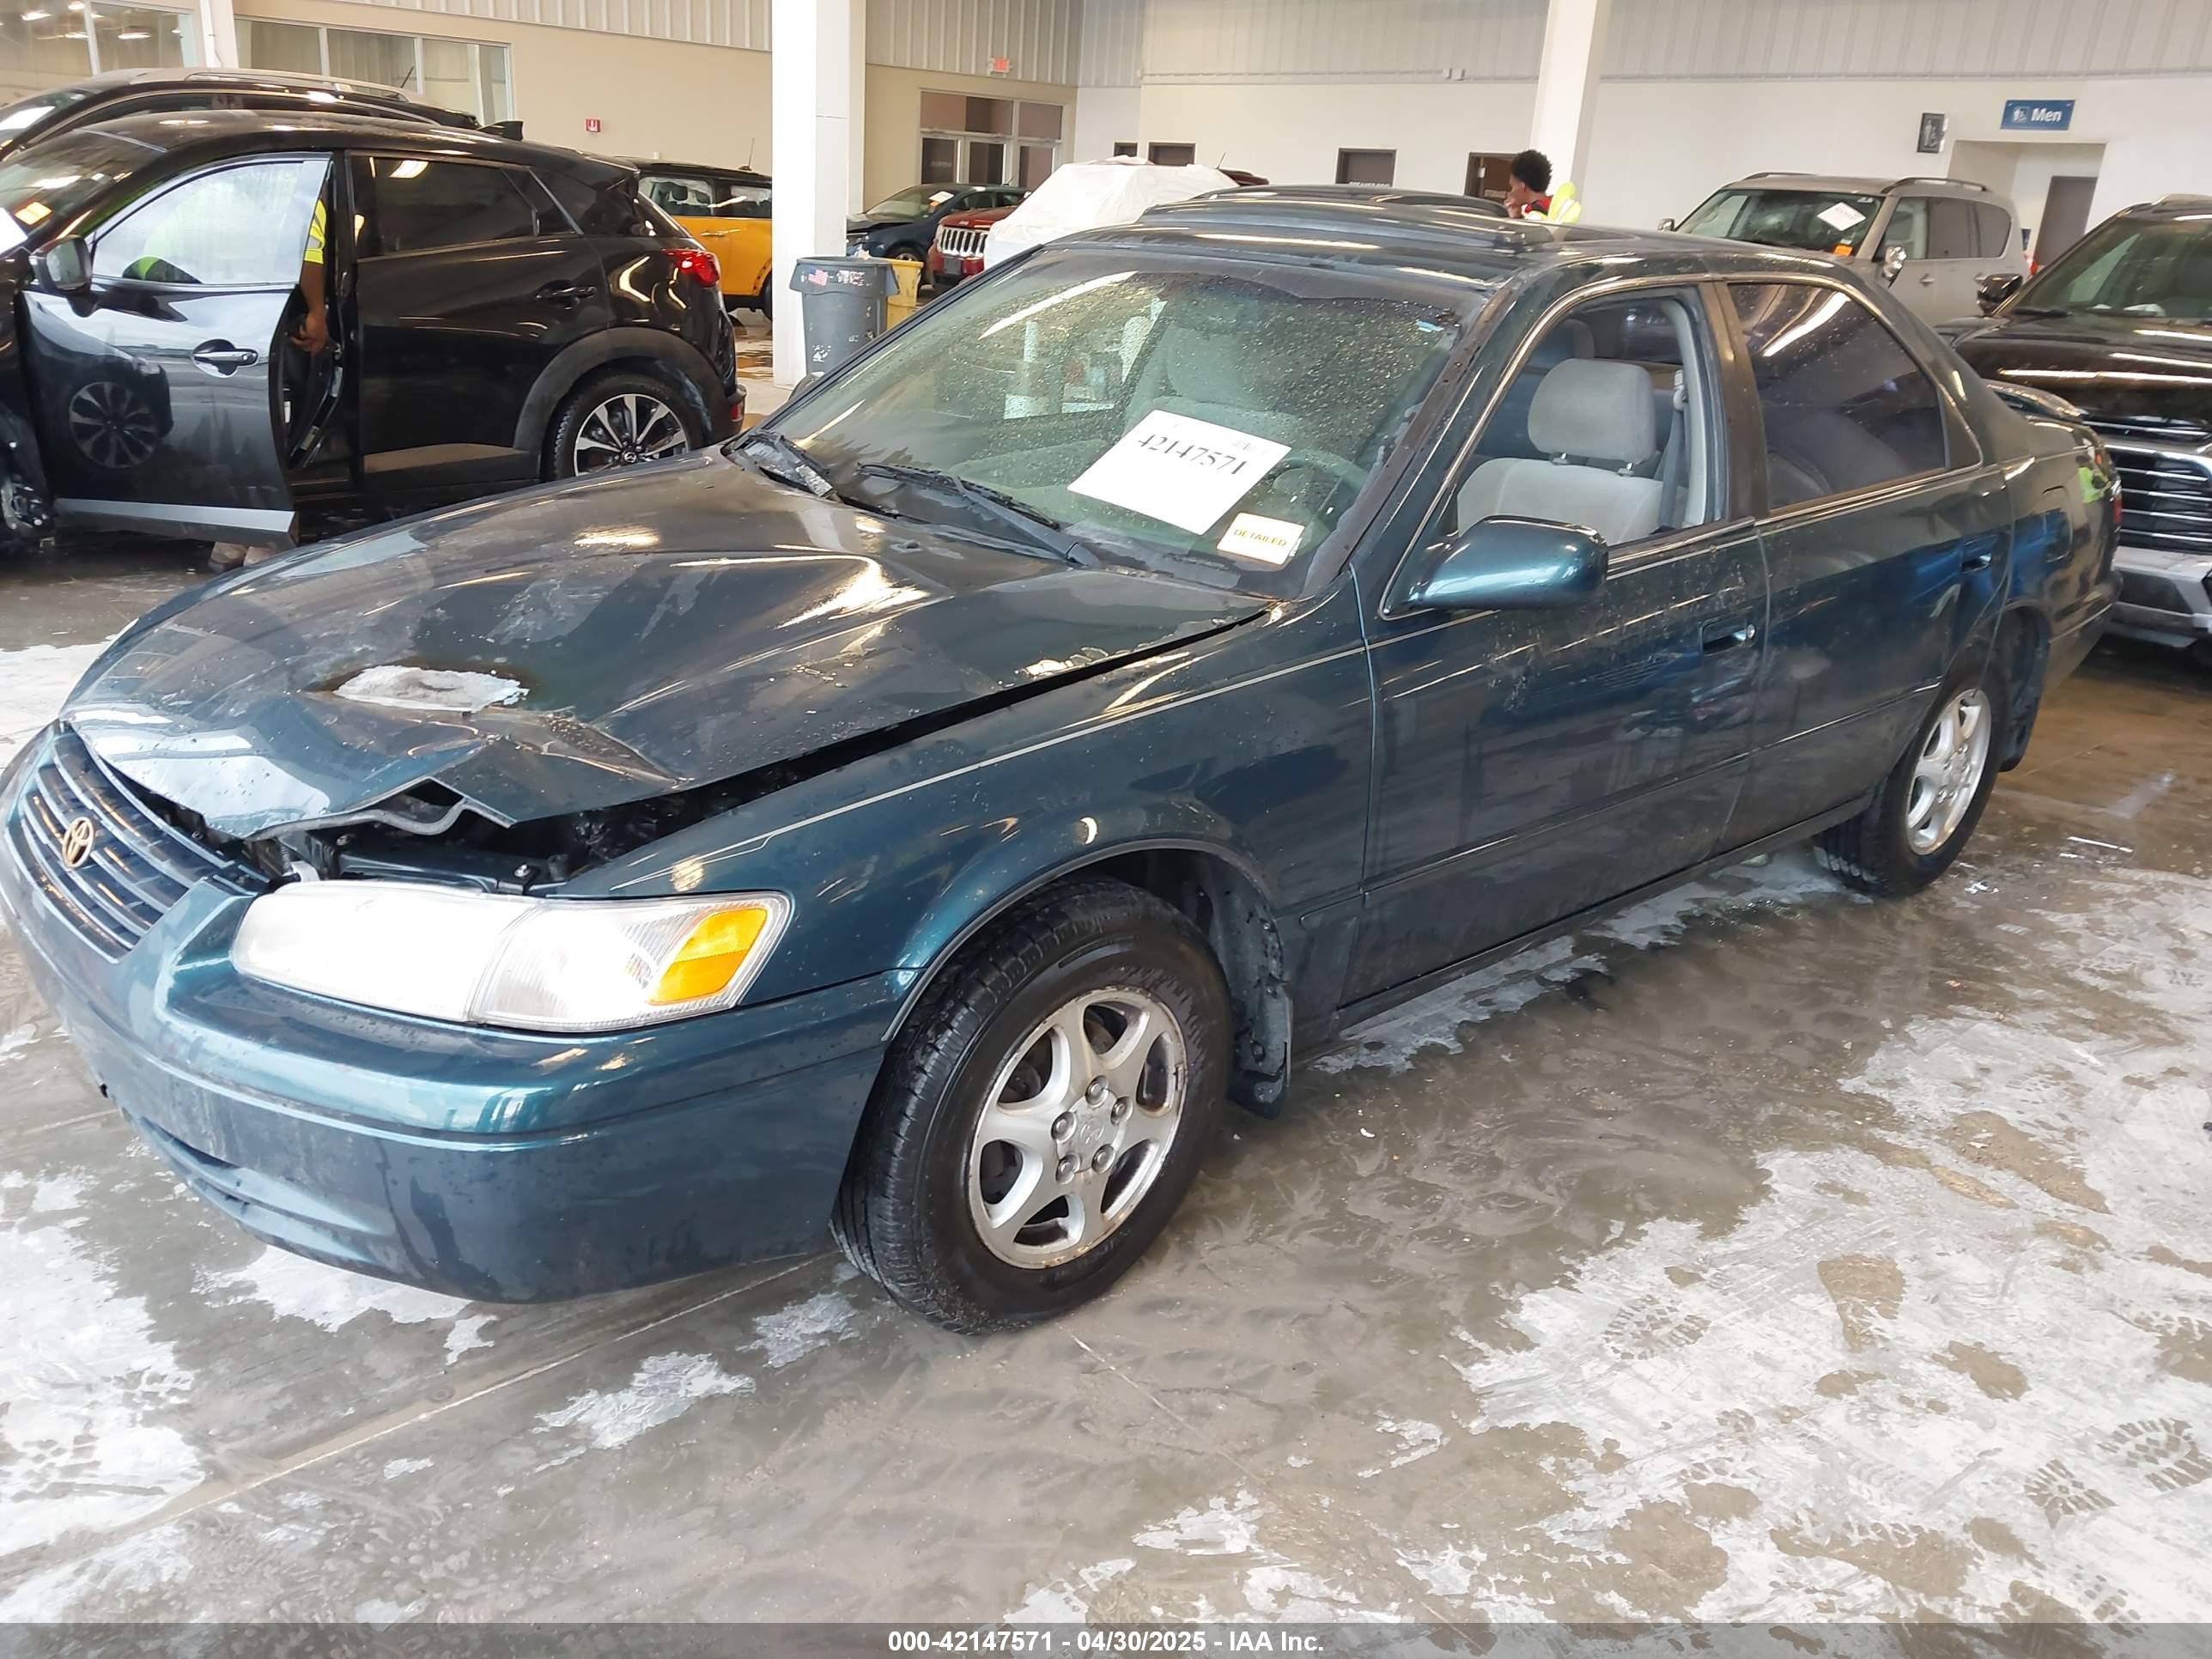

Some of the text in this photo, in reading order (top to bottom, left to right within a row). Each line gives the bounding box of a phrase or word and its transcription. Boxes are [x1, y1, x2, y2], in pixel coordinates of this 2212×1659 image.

[2030, 107, 2063, 122] Men
[1138, 433, 1248, 475] 42147571
[1233, 528, 1287, 547] DETAILED
